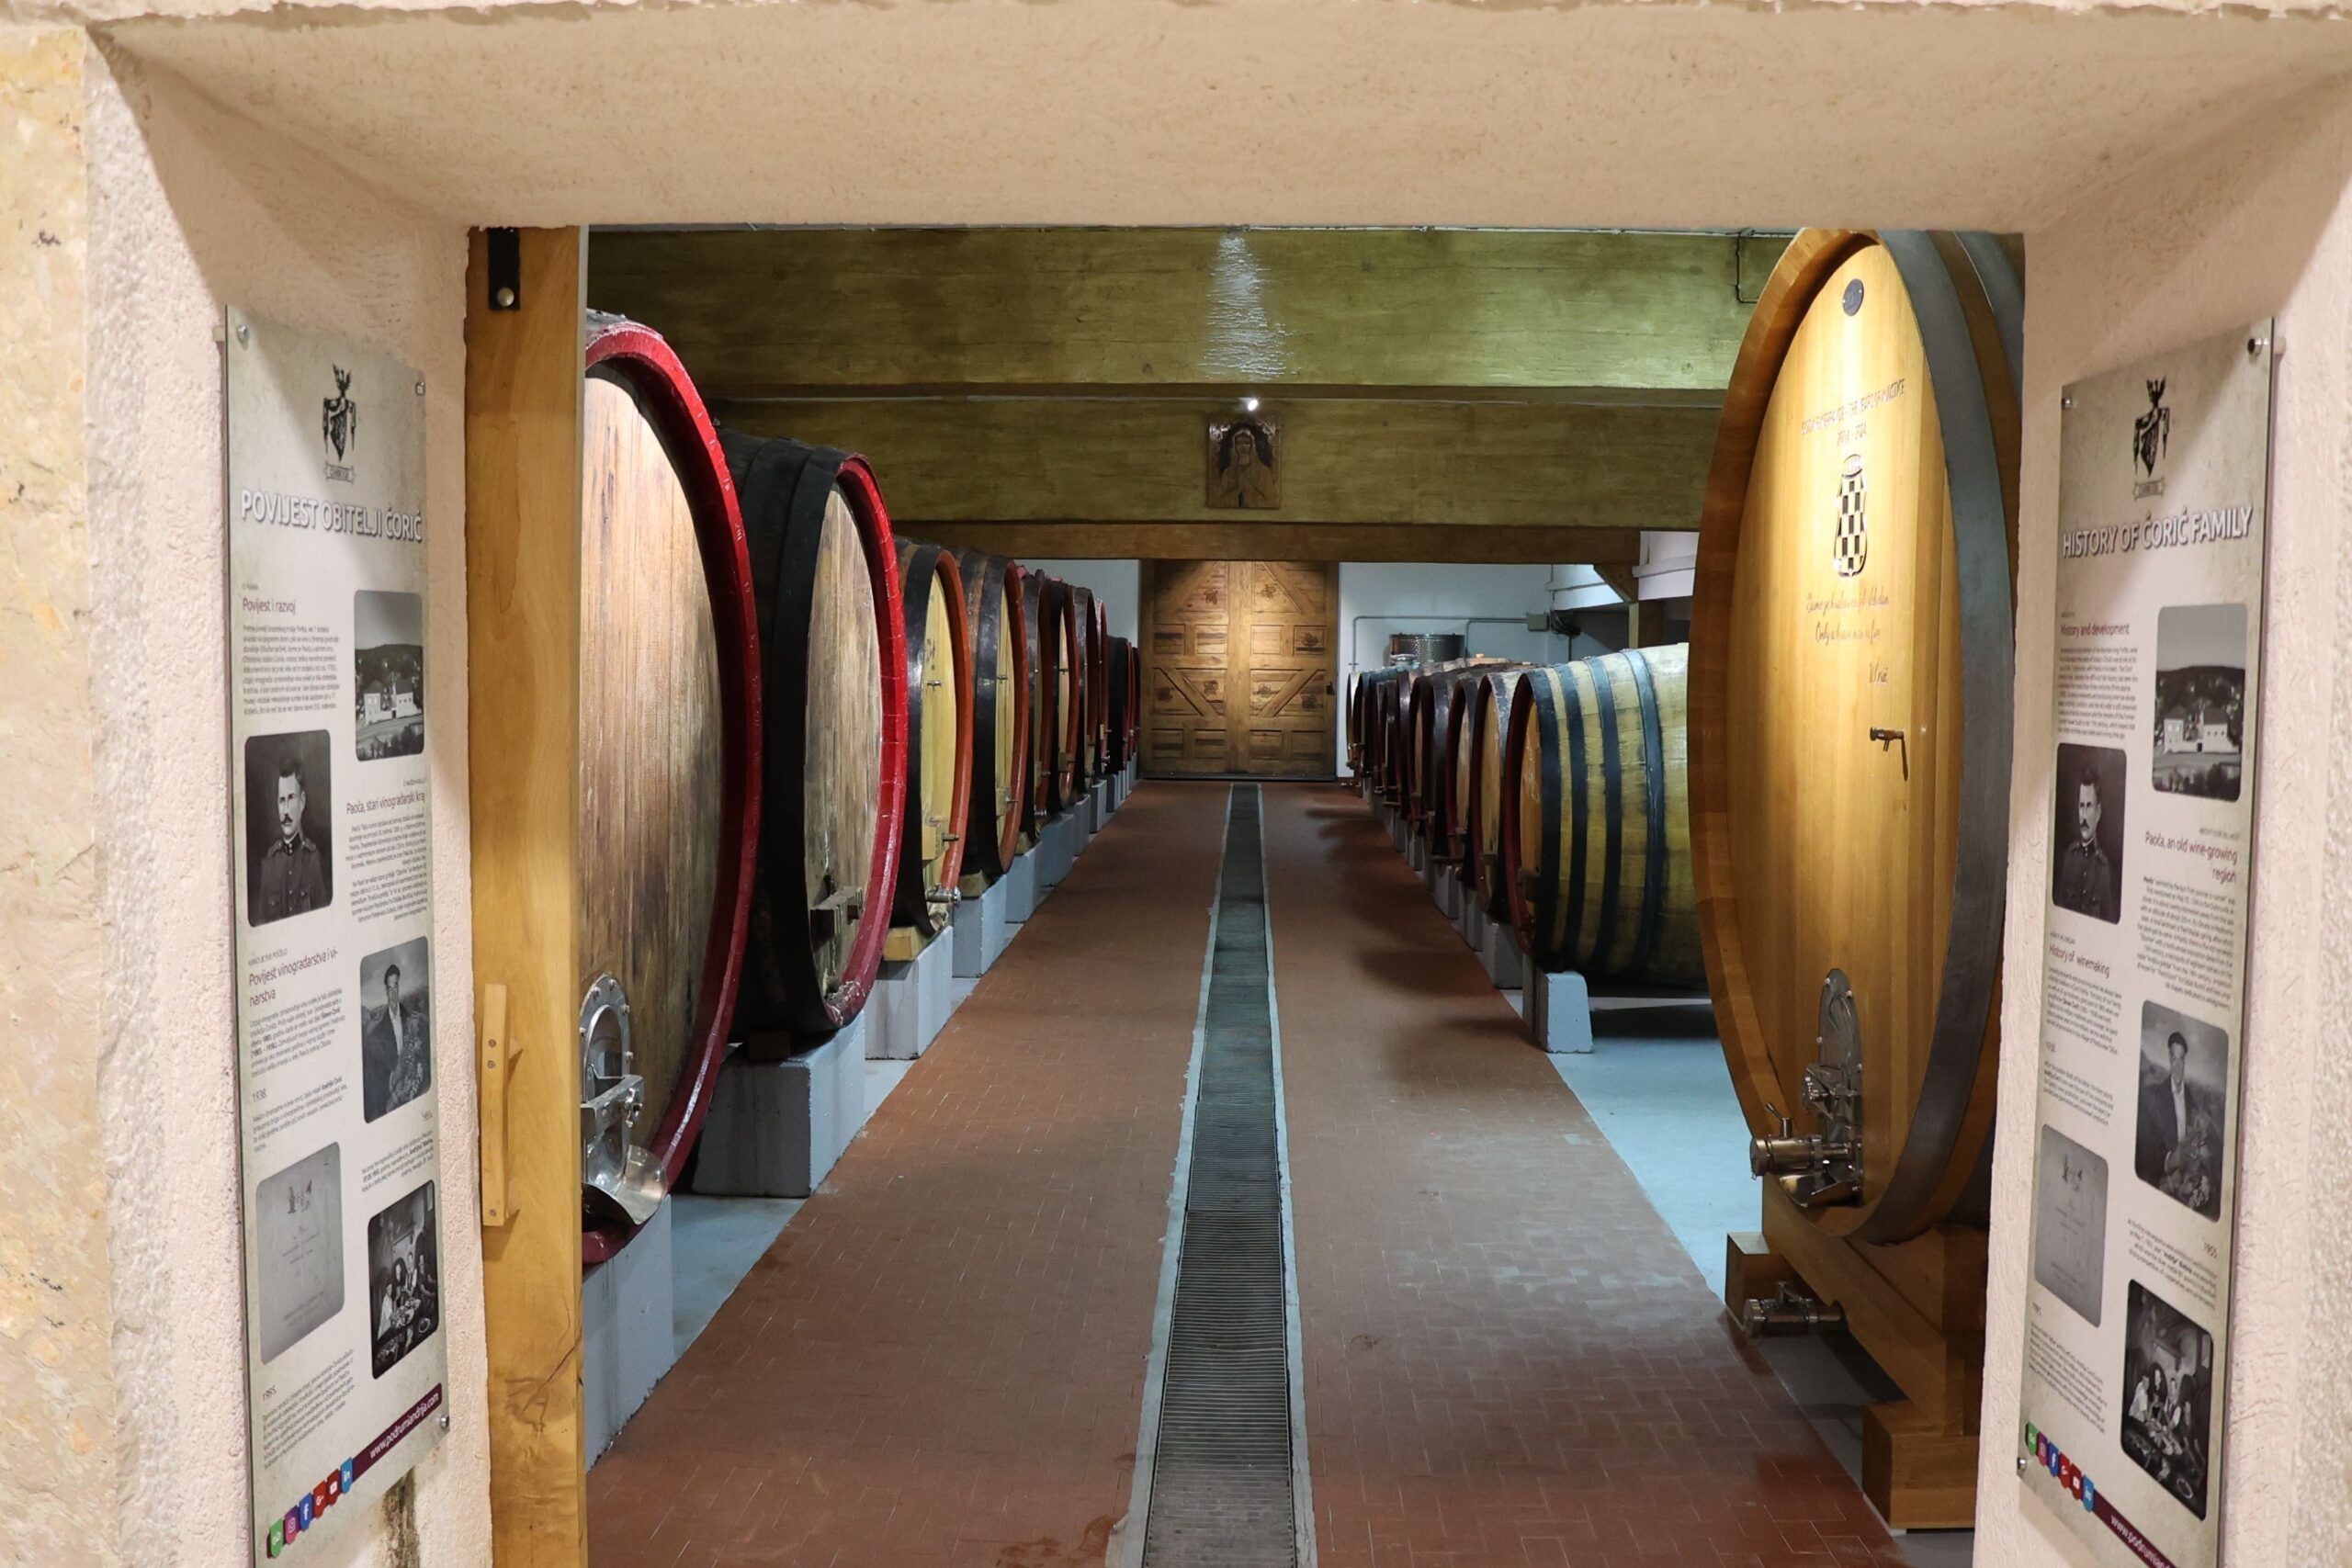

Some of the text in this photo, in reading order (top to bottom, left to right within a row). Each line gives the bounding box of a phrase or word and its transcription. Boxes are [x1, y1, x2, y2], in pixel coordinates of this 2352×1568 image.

[241, 489, 423, 543] POVIJEST OBITELJI ĆORIĆ
[2063, 505, 2254, 558] HISTORY OF ĆORIĆ FAMILY
[243, 597, 271, 615] Povijest
[276, 600, 296, 615] razvoj
[2167, 837, 2177, 850] an
[2177, 836, 2188, 852] old
[2188, 840, 2238, 866] wine-growing
[2212, 867, 2237, 885] region
[249, 966, 277, 987] Povijest
[277, 953, 326, 976] vinogradarstva
[249, 988, 277, 1008] narstva
[369, 1393, 439, 1459] www.podrumiandrija.com
